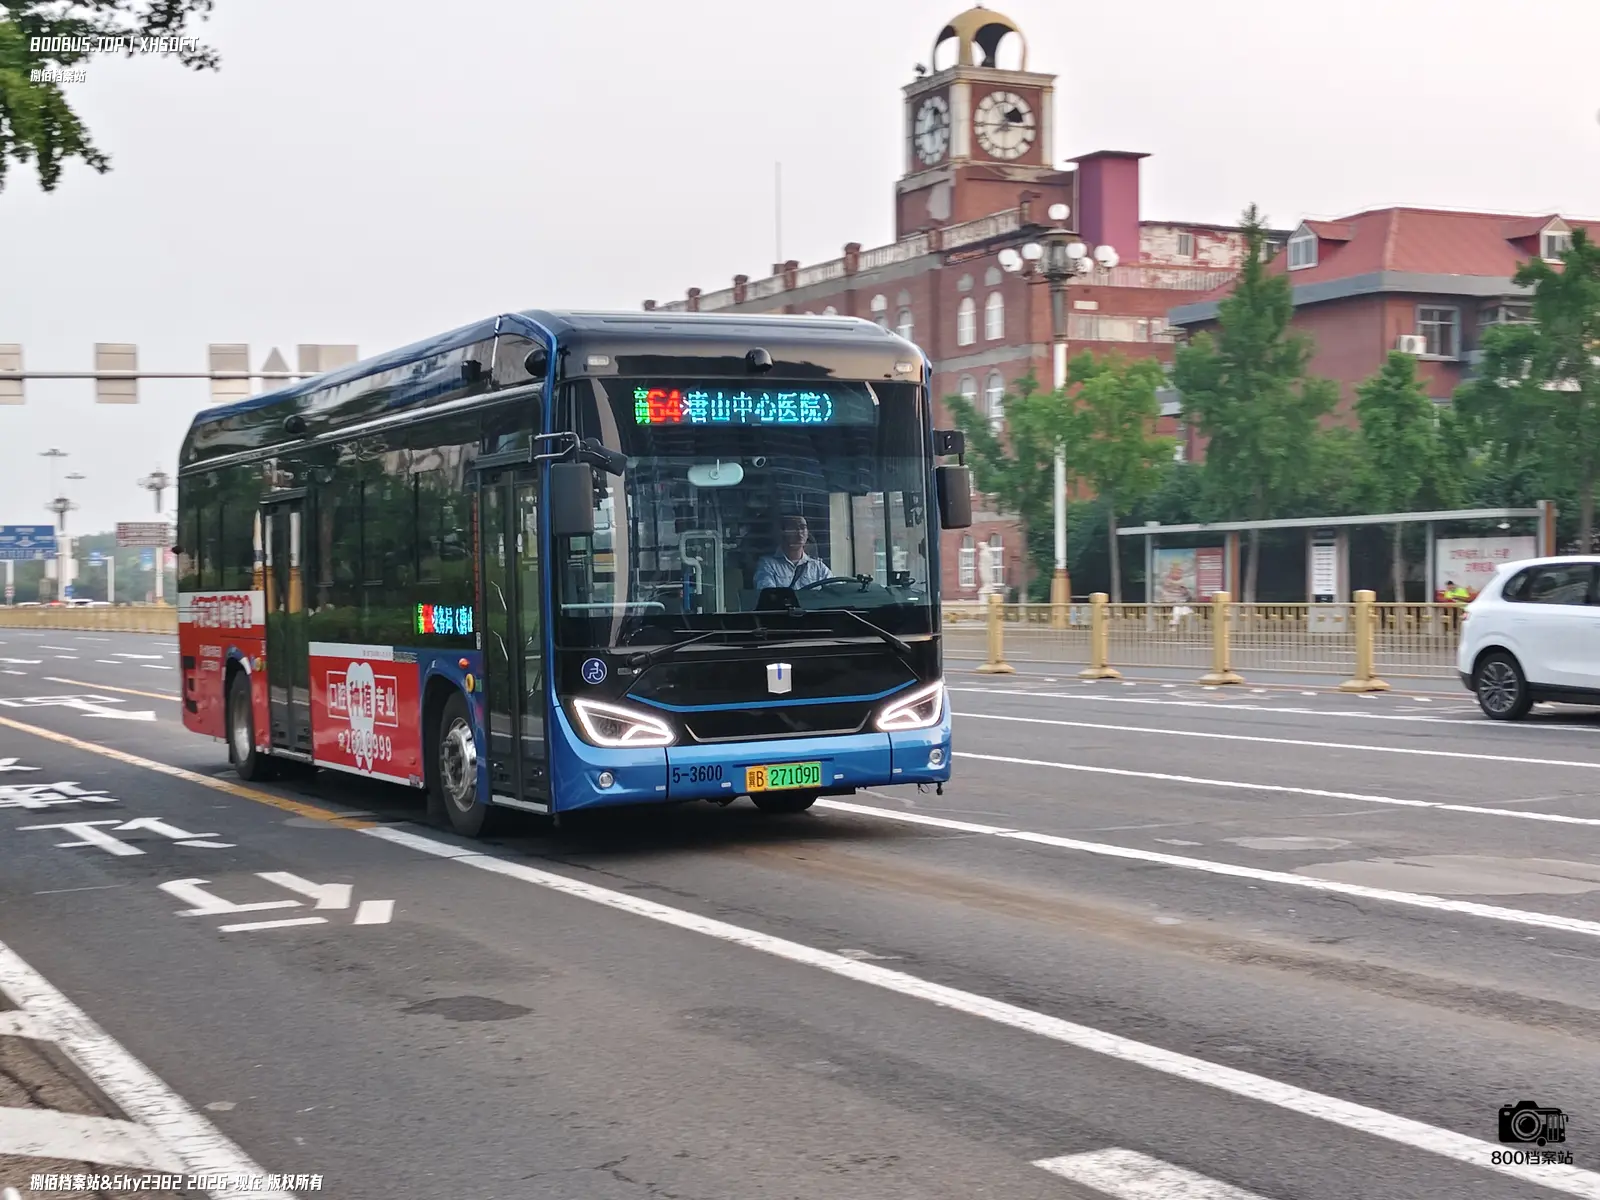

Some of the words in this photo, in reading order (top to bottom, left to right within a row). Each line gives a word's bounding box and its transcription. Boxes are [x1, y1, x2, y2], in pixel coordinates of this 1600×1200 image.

[328, 680, 396, 718] 口腔种植专业
[672, 765, 723, 784] 5-3600
[771, 766, 820, 787] 27109D
